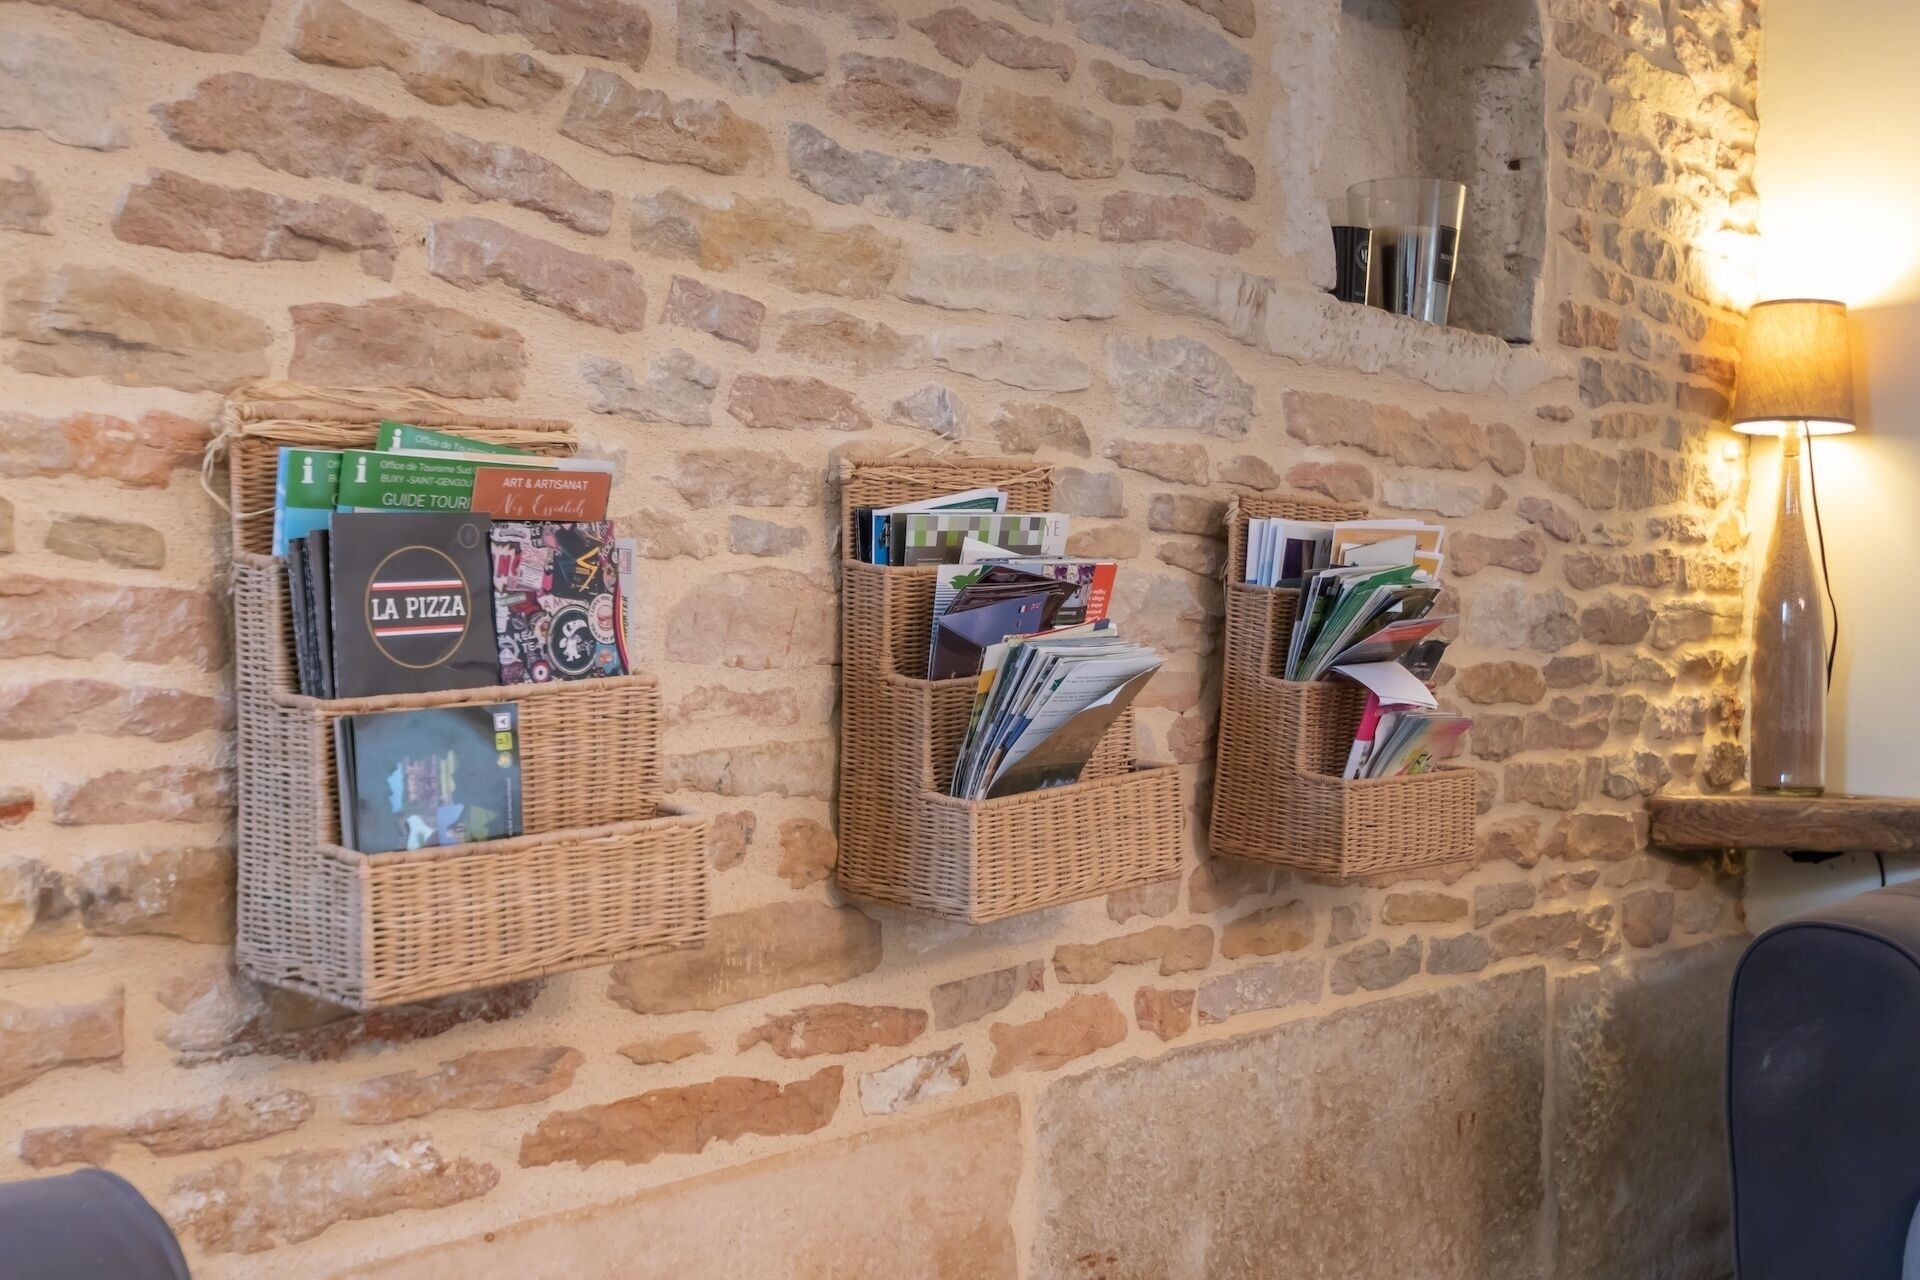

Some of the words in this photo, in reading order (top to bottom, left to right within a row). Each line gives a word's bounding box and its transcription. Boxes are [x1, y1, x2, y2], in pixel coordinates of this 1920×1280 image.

[380, 460, 405, 471] Office
[406, 462, 417, 471] de
[419, 462, 455, 473] Tourisme
[380, 474, 405, 484] BUXY
[503, 478, 523, 489] ART
[525, 479, 533, 488] &
[535, 479, 589, 490] ARTISANAT
[382, 492, 427, 508] GUIDE
[429, 494, 471, 510] TOURI
[371, 598, 400, 621] LA
[405, 595, 467, 619] PIZZA
